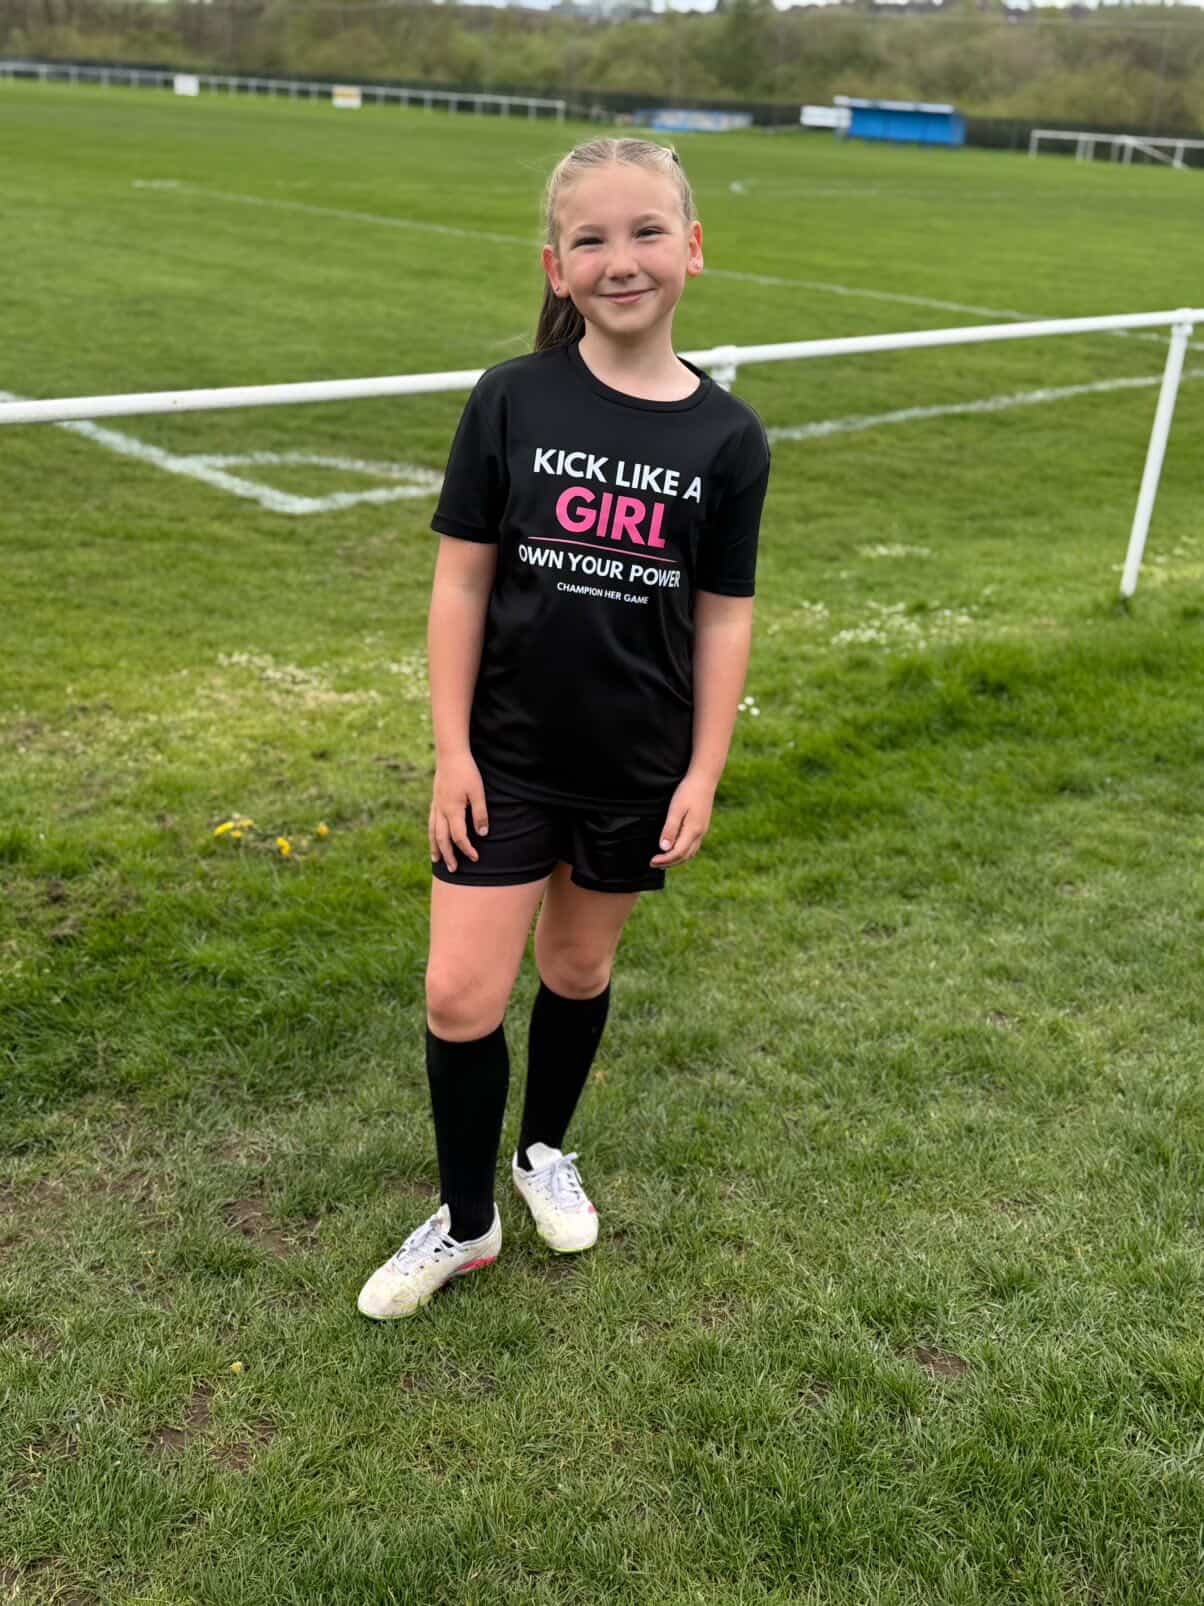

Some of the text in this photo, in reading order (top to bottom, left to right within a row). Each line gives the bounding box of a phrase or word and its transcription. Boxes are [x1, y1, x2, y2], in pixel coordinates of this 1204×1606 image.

[533, 447, 702, 504] KICK LIKE A
[555, 486, 666, 549] GIRL
[518, 544, 681, 588] OWN YOUR POWER
[556, 582, 649, 605] CHAMPION HER GAME
